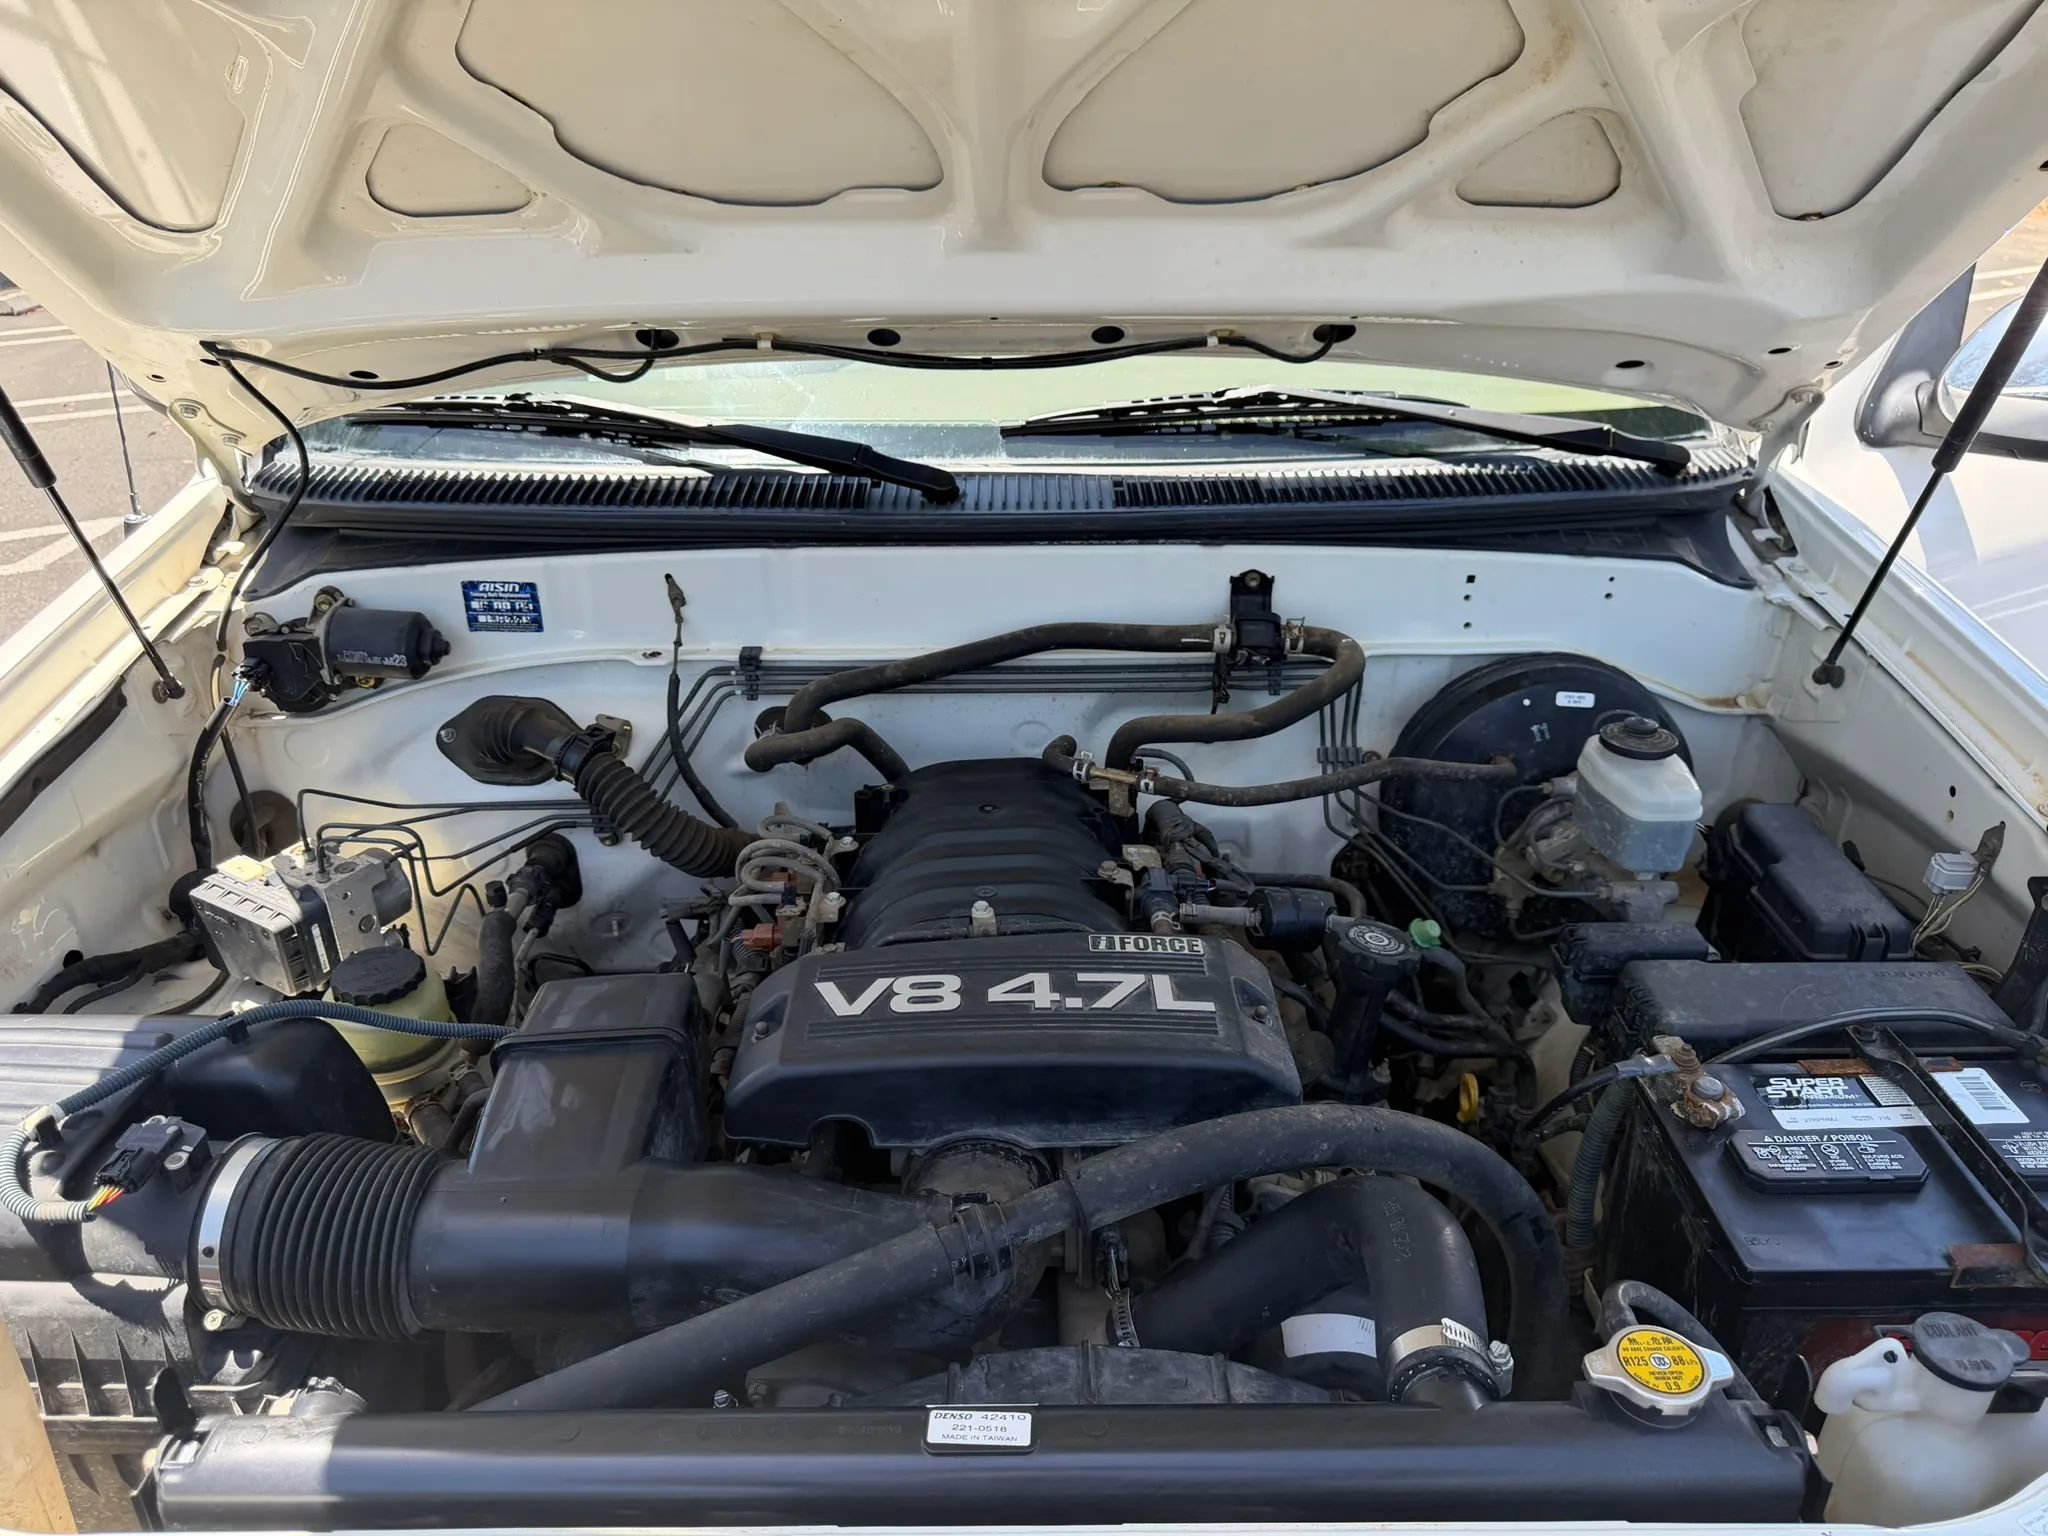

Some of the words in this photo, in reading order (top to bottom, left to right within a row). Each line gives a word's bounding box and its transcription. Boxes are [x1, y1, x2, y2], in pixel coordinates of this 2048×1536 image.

[479, 583, 519, 592] AISIN
[814, 974, 961, 1017] V8
[988, 972, 1216, 1012] 4.7L
[1769, 1077, 1845, 1087] SUPER
[1766, 1086, 1849, 1098] START
[1829, 1134, 1873, 1142] POISON
[1922, 1322, 1978, 1338] COOLANT
[1622, 1356, 1648, 1366] R125
[1671, 1356, 1686, 1366] 88
[1665, 1381, 1682, 1391] 0.9
[934, 1412, 973, 1420] DENSO
[952, 1424, 1008, 1433] 221-0518
[982, 1434, 1018, 1442] TAIWAN
